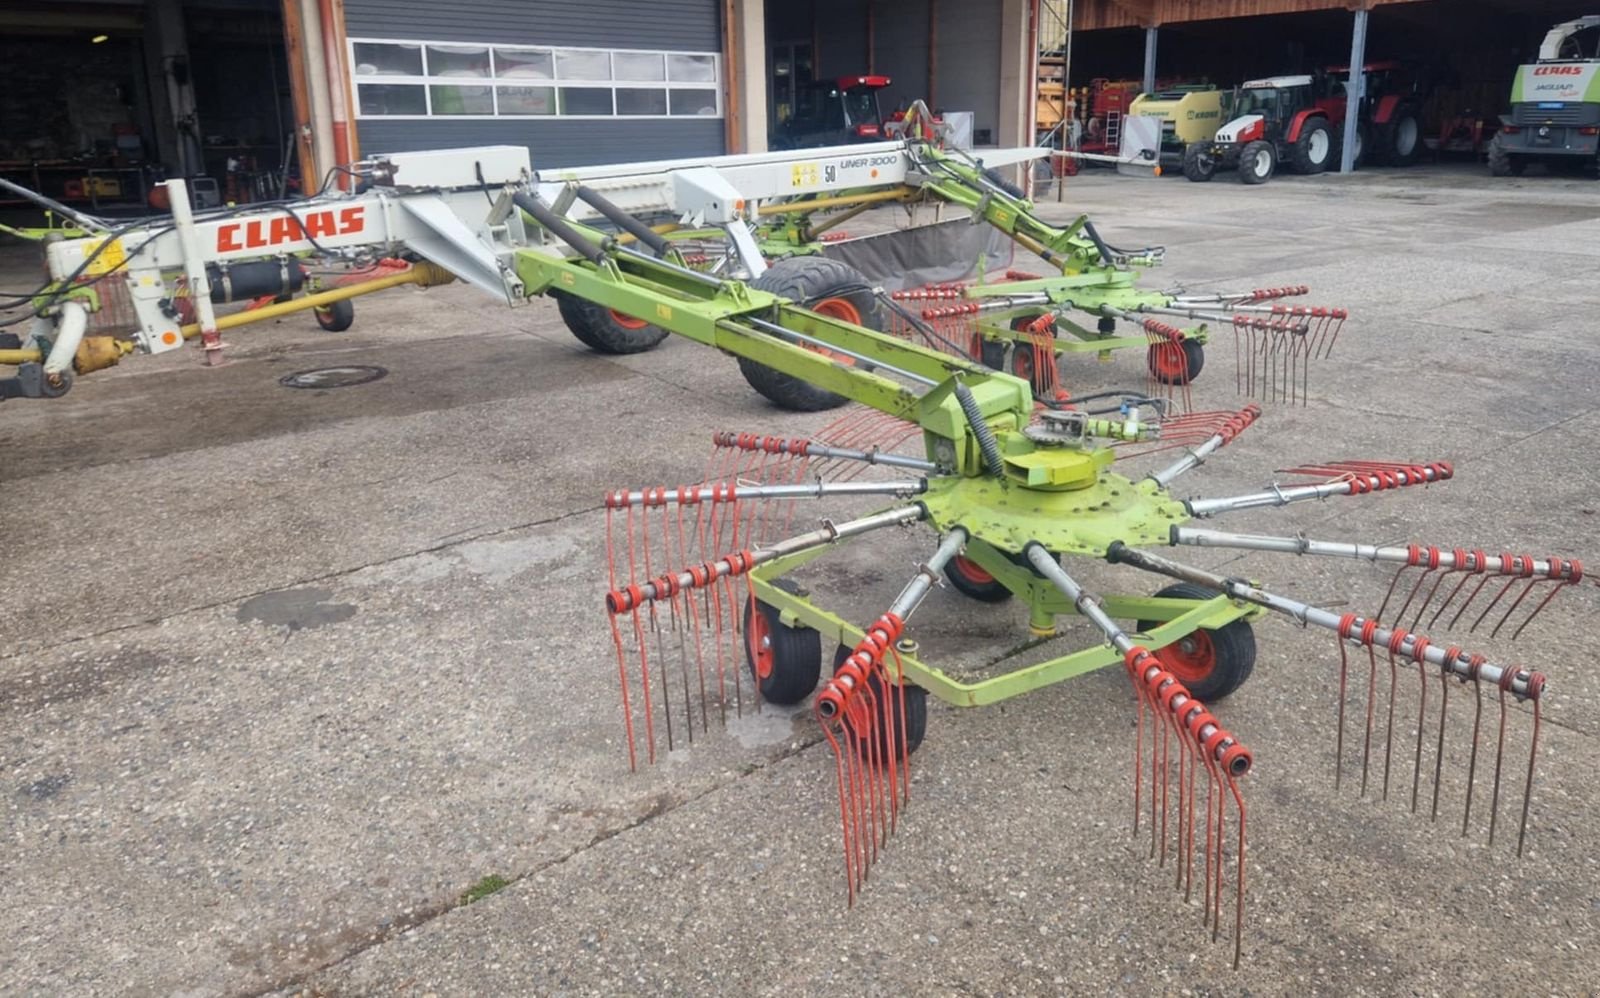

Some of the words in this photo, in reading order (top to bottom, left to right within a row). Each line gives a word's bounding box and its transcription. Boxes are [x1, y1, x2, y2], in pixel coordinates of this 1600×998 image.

[1533, 66, 1584, 76] CLAAS
[1195, 110, 1219, 119] KRONE
[869, 155, 897, 168] 3000
[824, 164, 836, 183] 50
[217, 206, 365, 253] CLAAS
